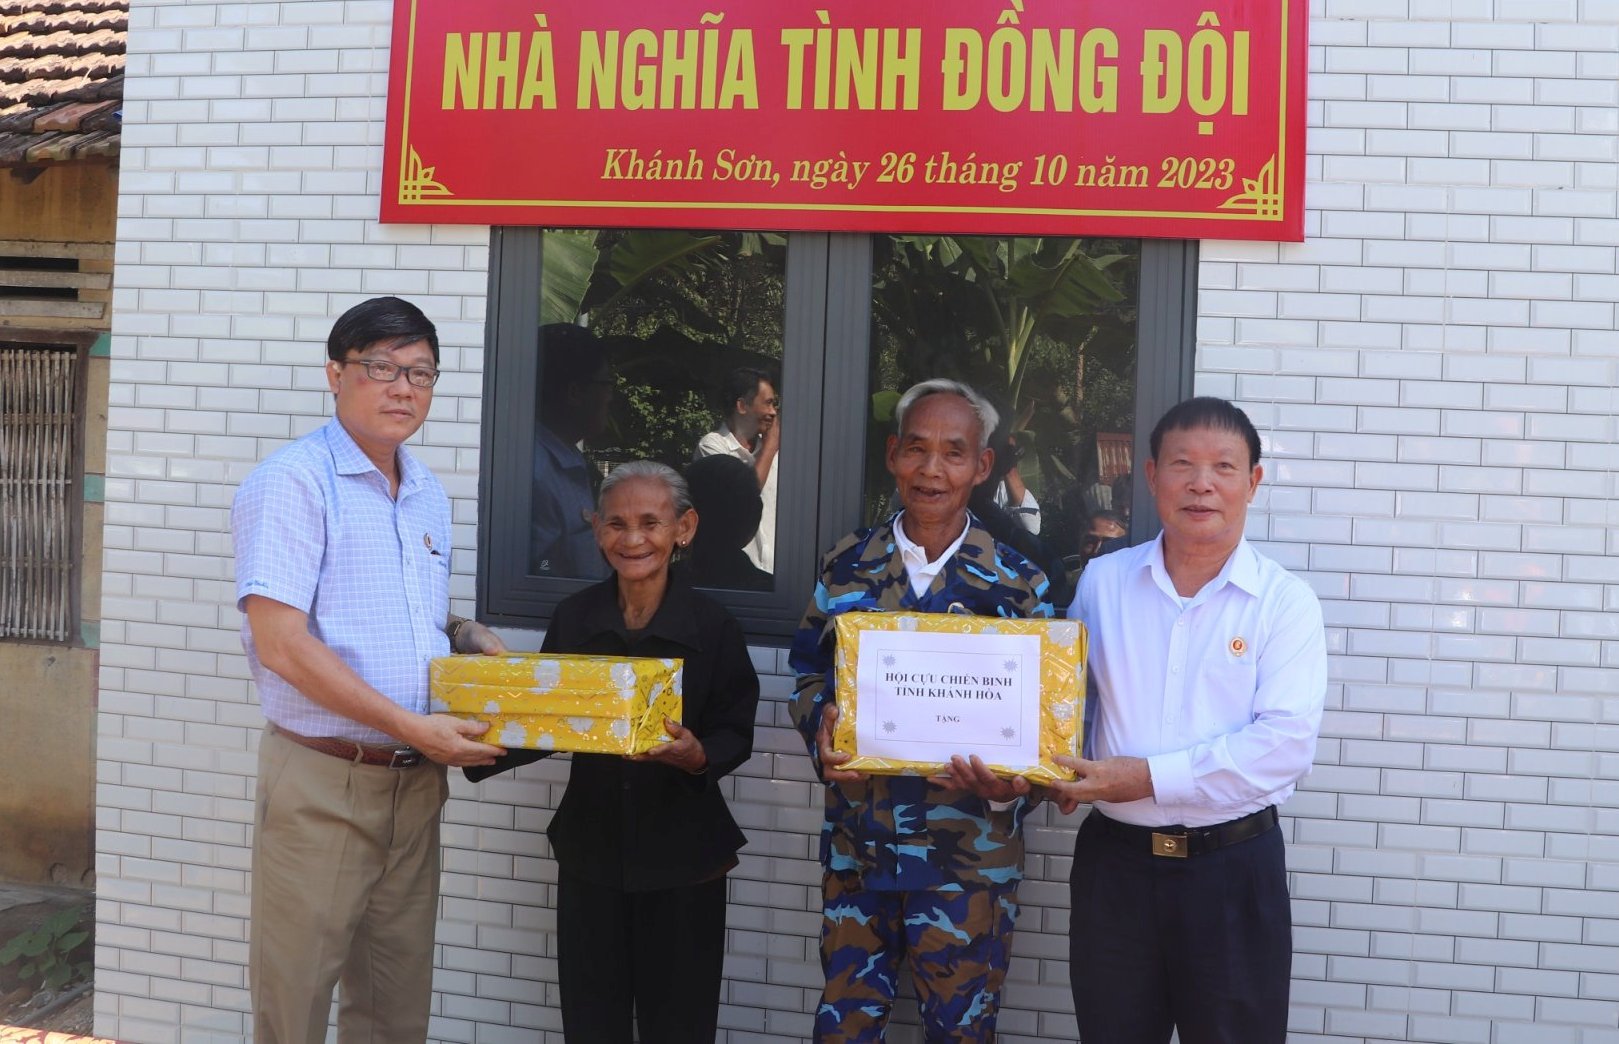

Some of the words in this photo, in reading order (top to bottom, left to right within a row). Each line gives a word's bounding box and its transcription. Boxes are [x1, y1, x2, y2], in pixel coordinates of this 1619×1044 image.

[441, 13, 557, 110] NHÀ
[576, 12, 759, 111] NGHĨA
[780, 10, 922, 111] TÌNH
[941, 0, 1119, 113] ĐỒNG
[1139, 11, 1250, 135] ĐỘI
[600, 148, 704, 181] Khánh
[712, 148, 781, 188] Sơn,
[789, 151, 871, 190] ngày
[876, 152, 917, 184] 26
[924, 151, 1023, 192] tháng
[1030, 154, 1068, 186] 10
[1074, 155, 1149, 188] năm
[1157, 157, 1236, 190] 2023
[885, 671, 909, 685] HỘI
[982, 676, 1013, 687] BINH
